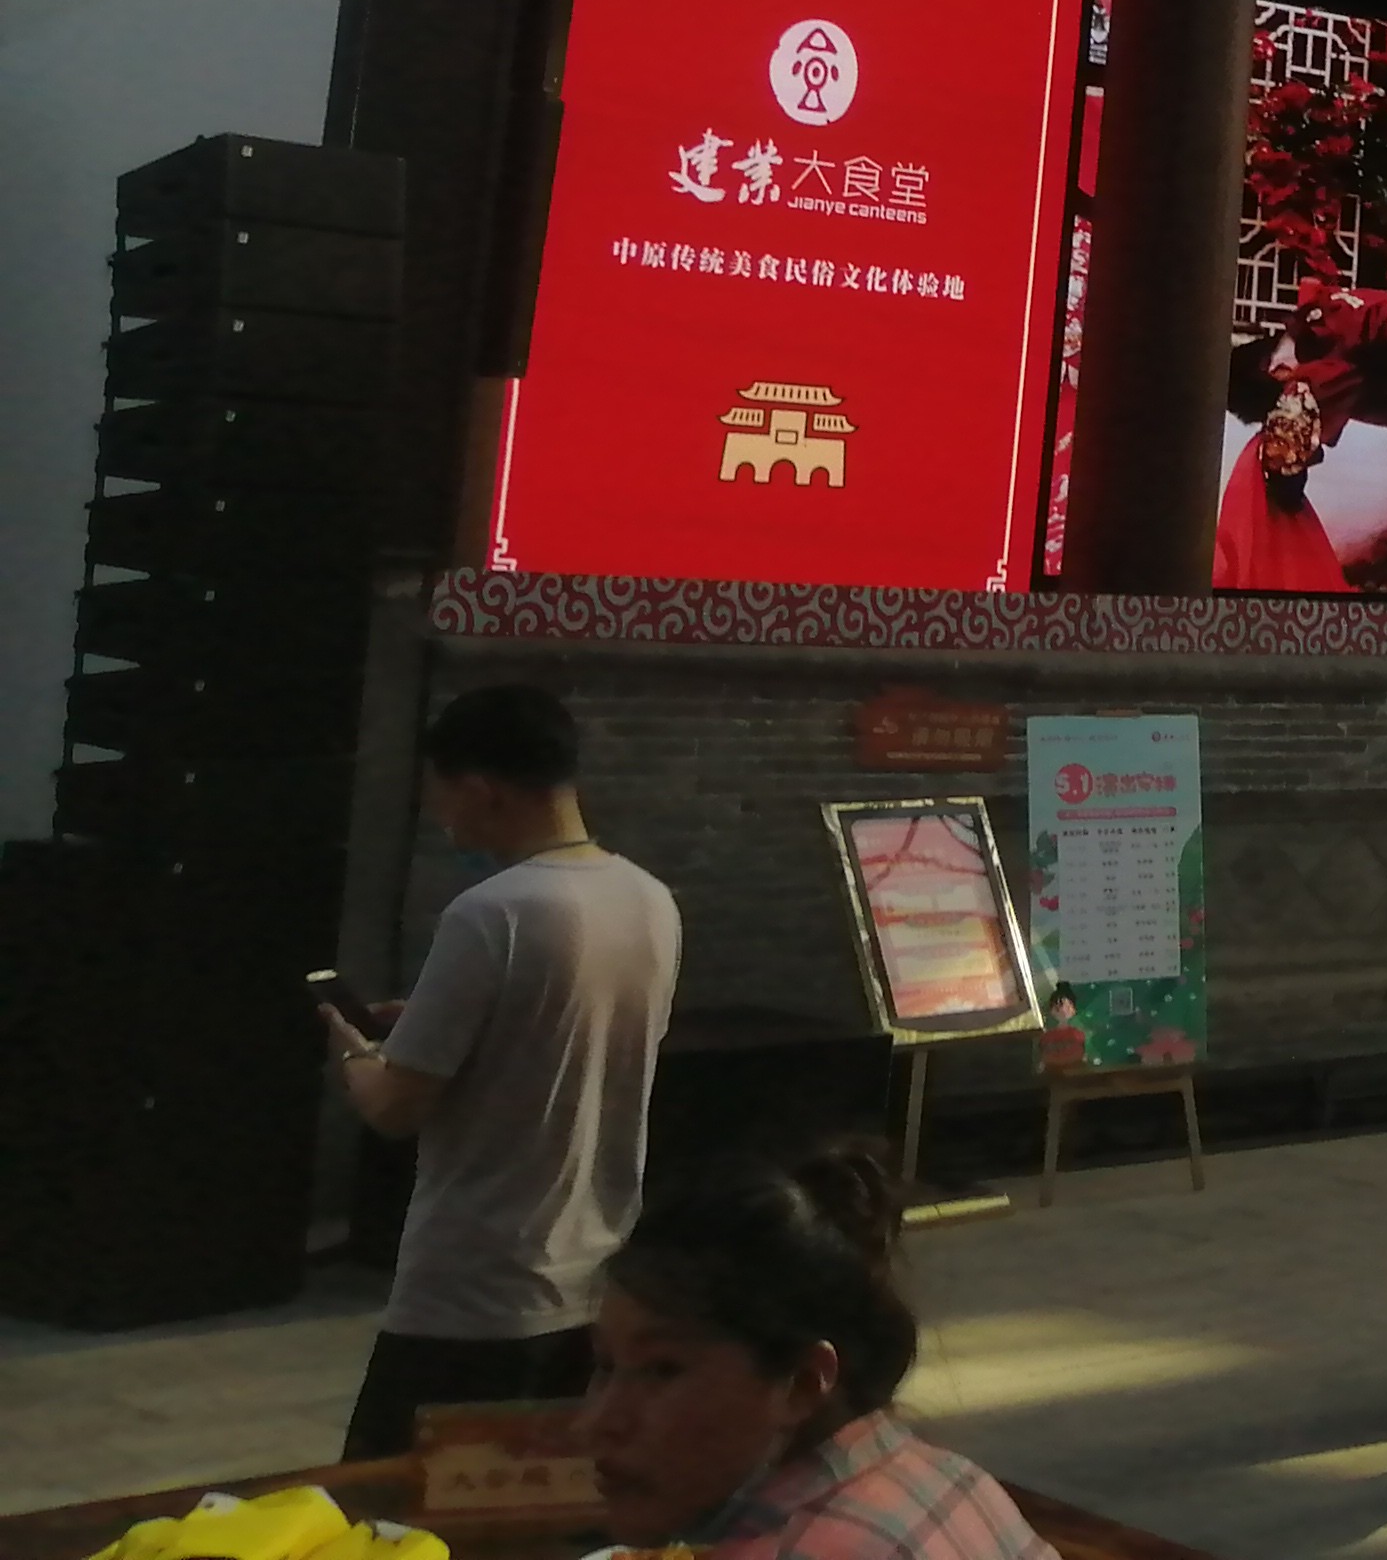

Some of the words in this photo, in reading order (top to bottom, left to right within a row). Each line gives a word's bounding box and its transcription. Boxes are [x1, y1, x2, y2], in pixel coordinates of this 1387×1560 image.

[849, 203, 928, 225] canteens
[612, 237, 966, 301] 中原传统美食民俗文化体验地
